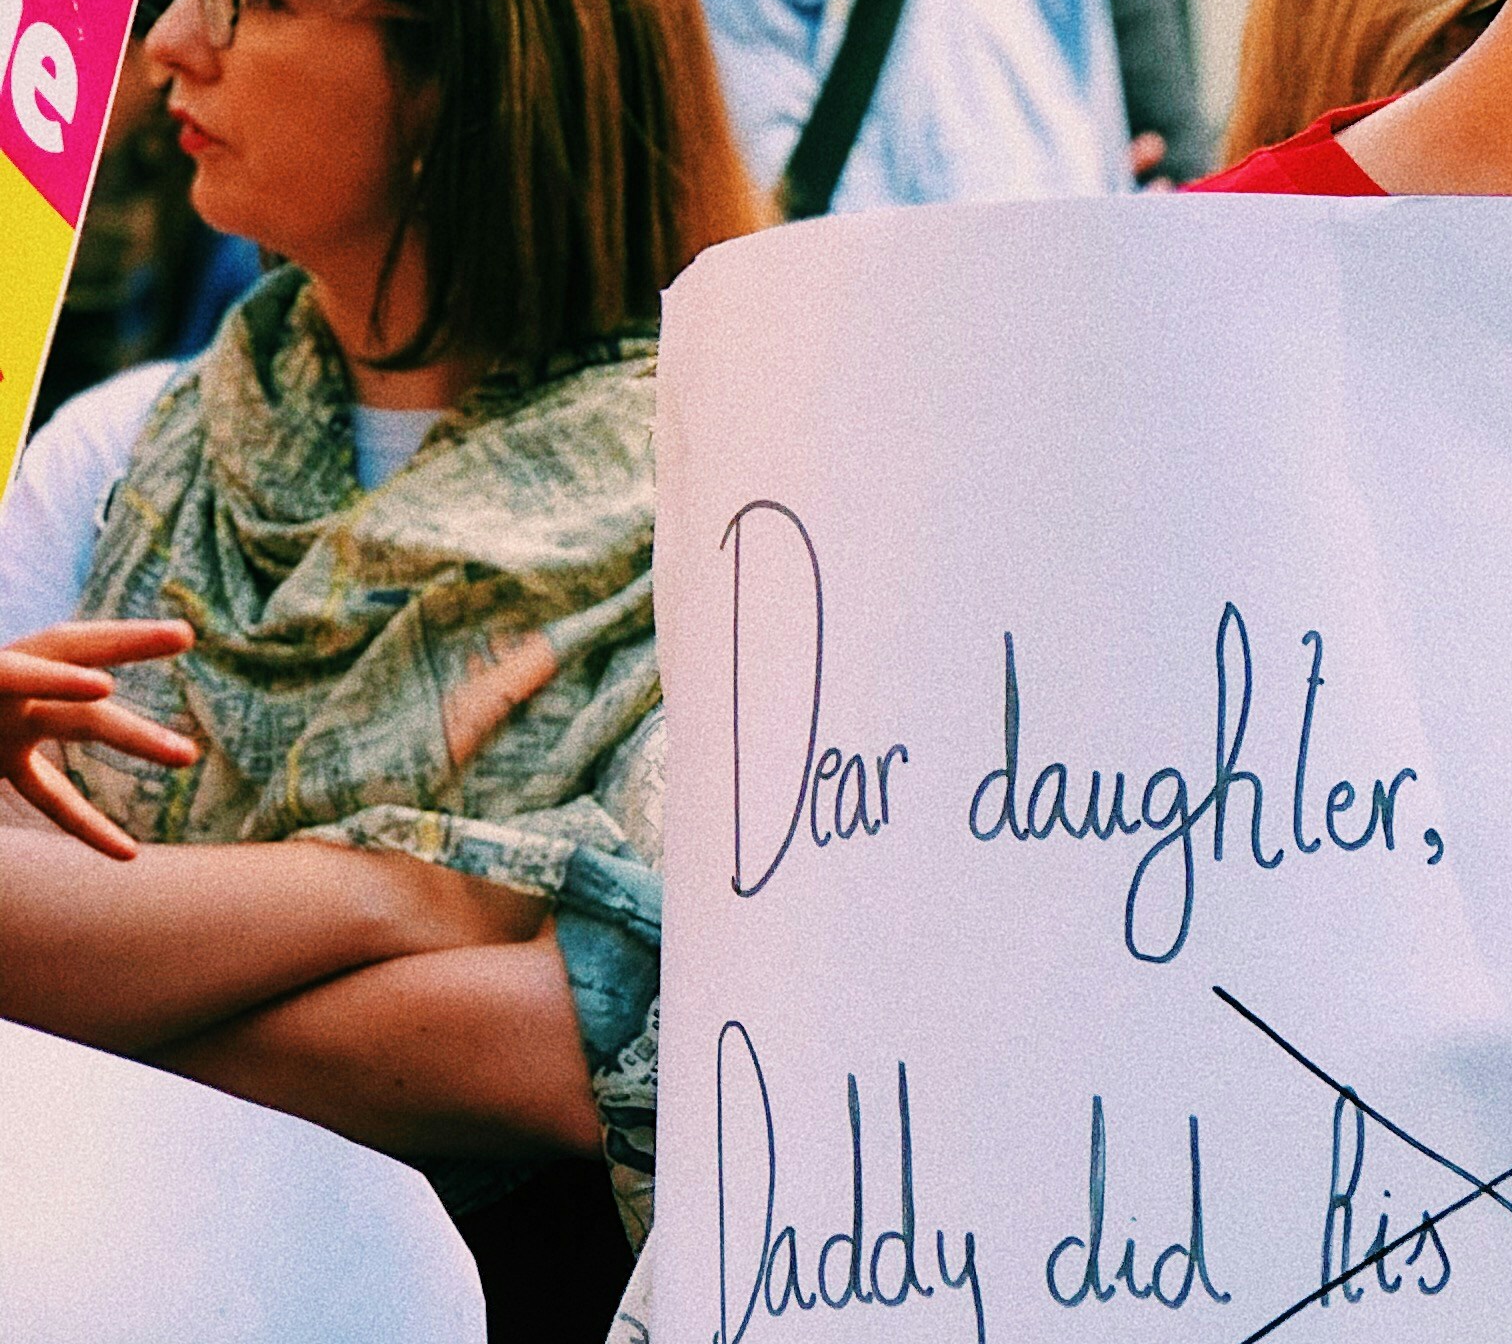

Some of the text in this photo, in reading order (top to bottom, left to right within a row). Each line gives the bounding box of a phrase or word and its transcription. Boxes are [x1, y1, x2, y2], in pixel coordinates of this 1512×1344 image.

[719, 499, 1446, 965] Dear daughter,
[1045, 1094, 1232, 1311] did
[1321, 1085, 1452, 1307] his
